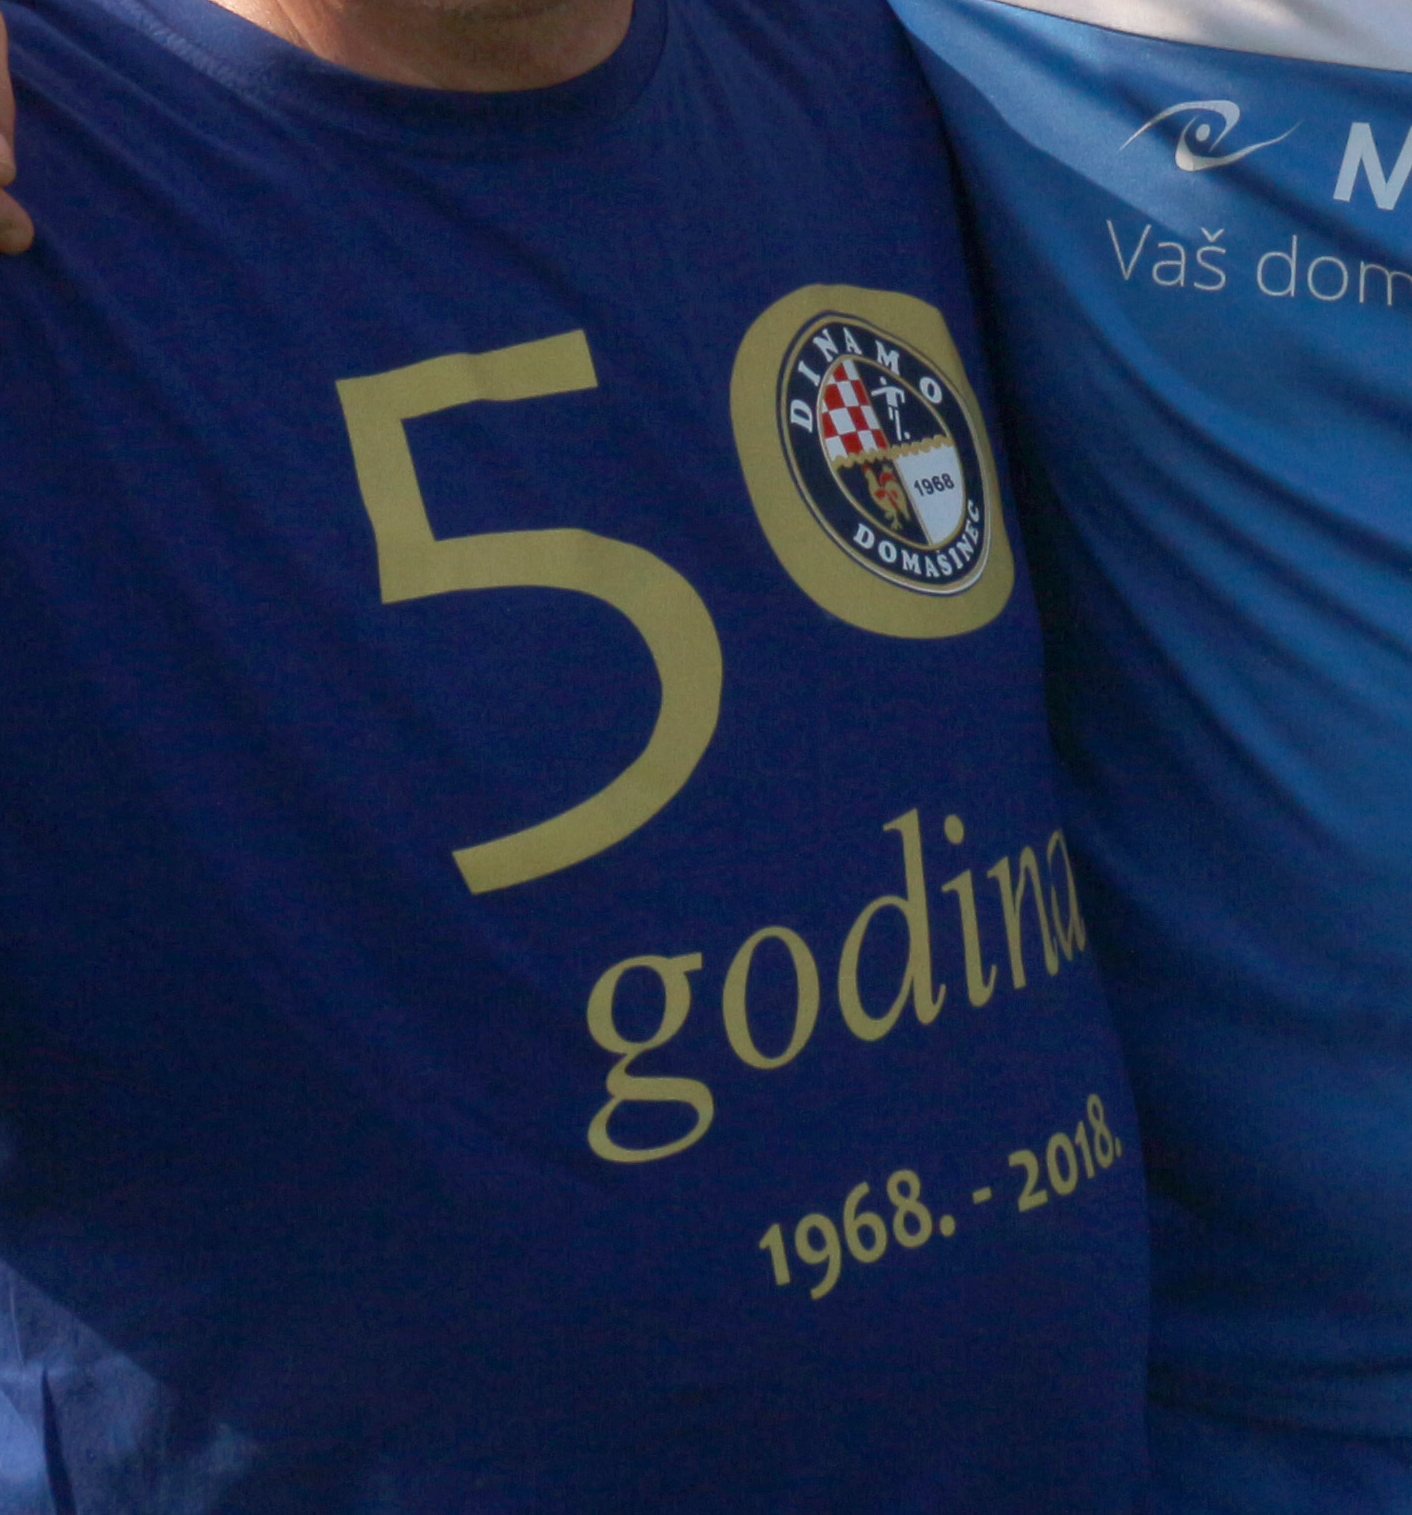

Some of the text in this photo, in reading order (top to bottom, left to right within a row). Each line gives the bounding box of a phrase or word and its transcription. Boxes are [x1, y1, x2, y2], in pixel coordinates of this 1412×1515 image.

[1105, 218, 1228, 292] Vaš
[790, 326, 943, 434] DINAMO
[913, 473, 955, 497] 1968
[852, 499, 980, 578] DOMAŠINEC
[586, 807, 1086, 1163] godina
[758, 1169, 957, 1301] 1968.
[1008, 1093, 1123, 1213] 2018.
